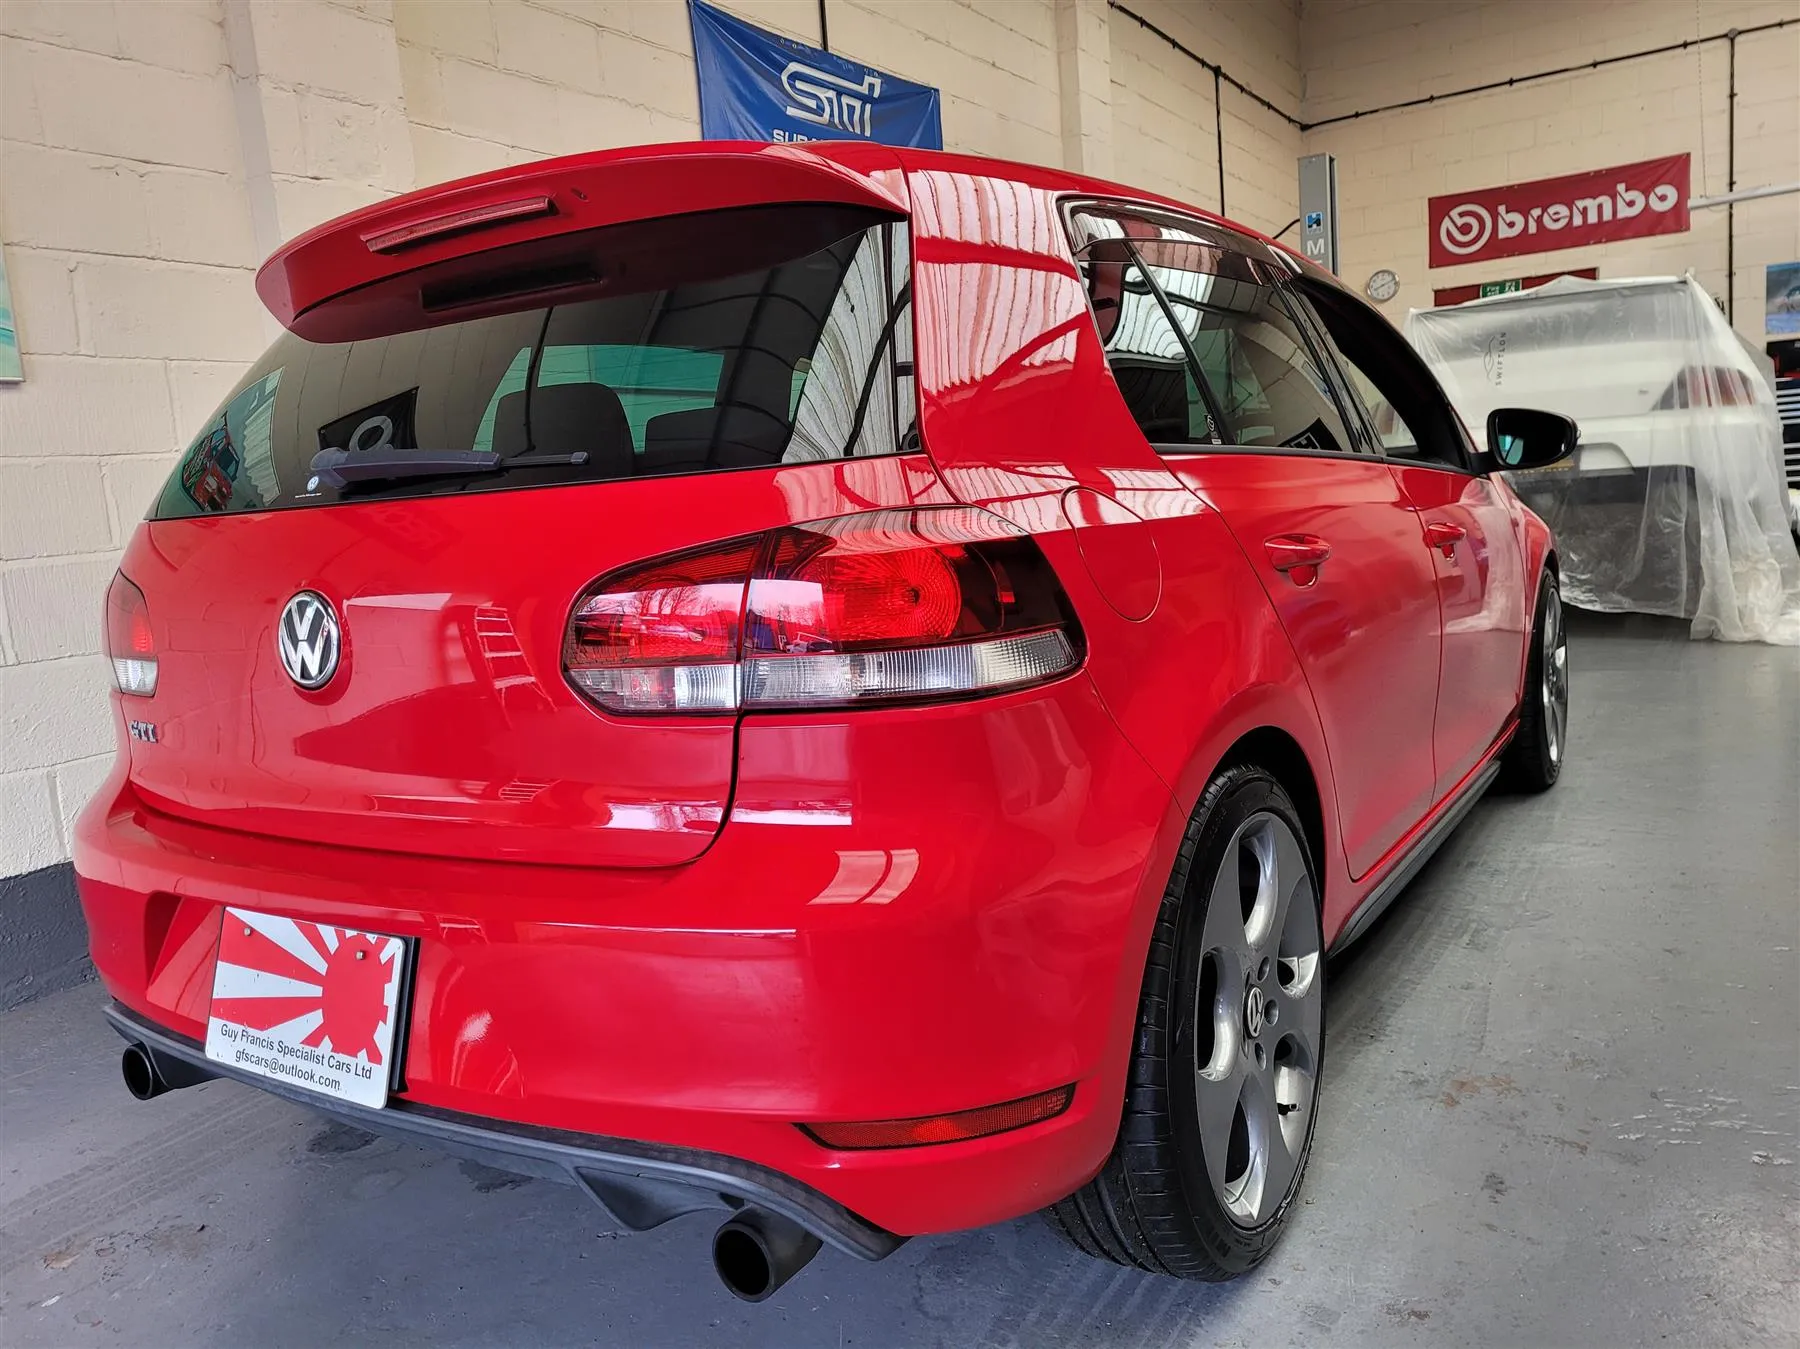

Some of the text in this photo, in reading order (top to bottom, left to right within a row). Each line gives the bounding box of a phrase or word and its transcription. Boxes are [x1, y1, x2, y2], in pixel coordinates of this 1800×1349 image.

[1497, 182, 1678, 240] brembo
[221, 1023, 372, 1080] Guy Francis Specialist Cars Ltd
[235, 1049, 341, 1091] gfscars@outlook.com
